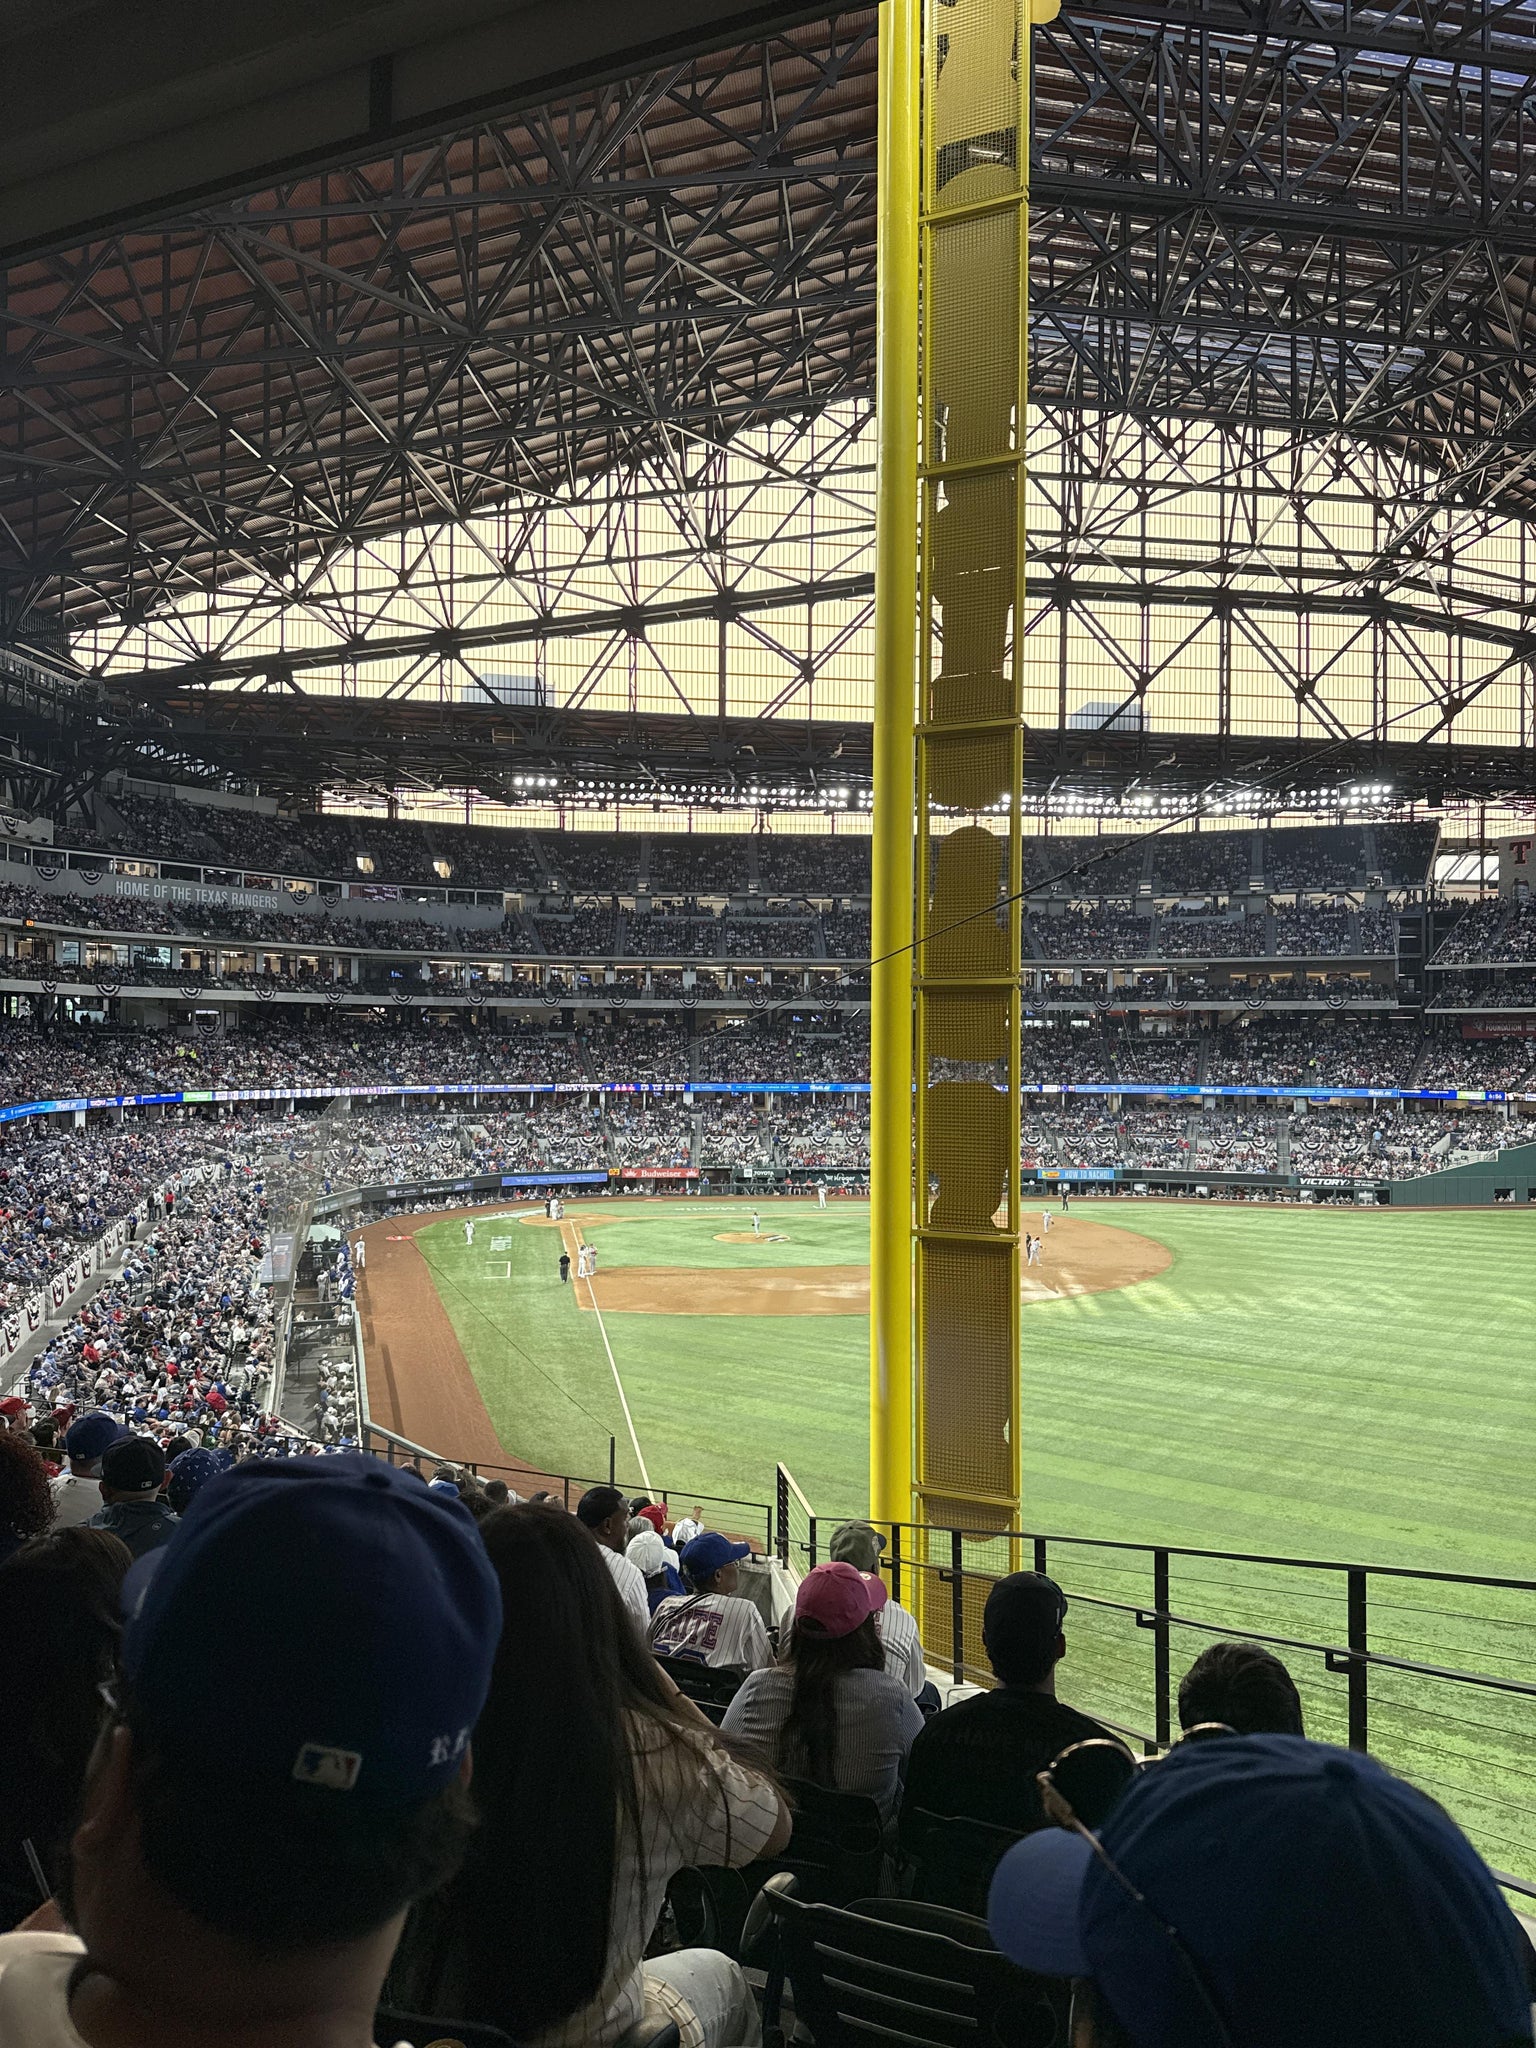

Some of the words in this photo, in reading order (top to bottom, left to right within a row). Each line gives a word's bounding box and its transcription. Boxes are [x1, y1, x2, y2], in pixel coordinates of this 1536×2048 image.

[1510, 840, 1532, 865] T
[116, 880, 150, 897] HOME
[153, 884, 168, 899] OF
[171, 886, 192, 901] THE
[195, 888, 229, 904] TEXAS
[231, 892, 278, 909] RANGERS
[1485, 1023, 1522, 1032] FOUNDATION
[641, 1170, 682, 1178] Budweiser
[833, 1172, 856, 1185] Kroger
[1064, 1169, 1078, 1179] HOW
[1080, 1169, 1087, 1179] TO
[1088, 1169, 1110, 1179] NACHO!
[1300, 1178, 1348, 1186] VICTORY
